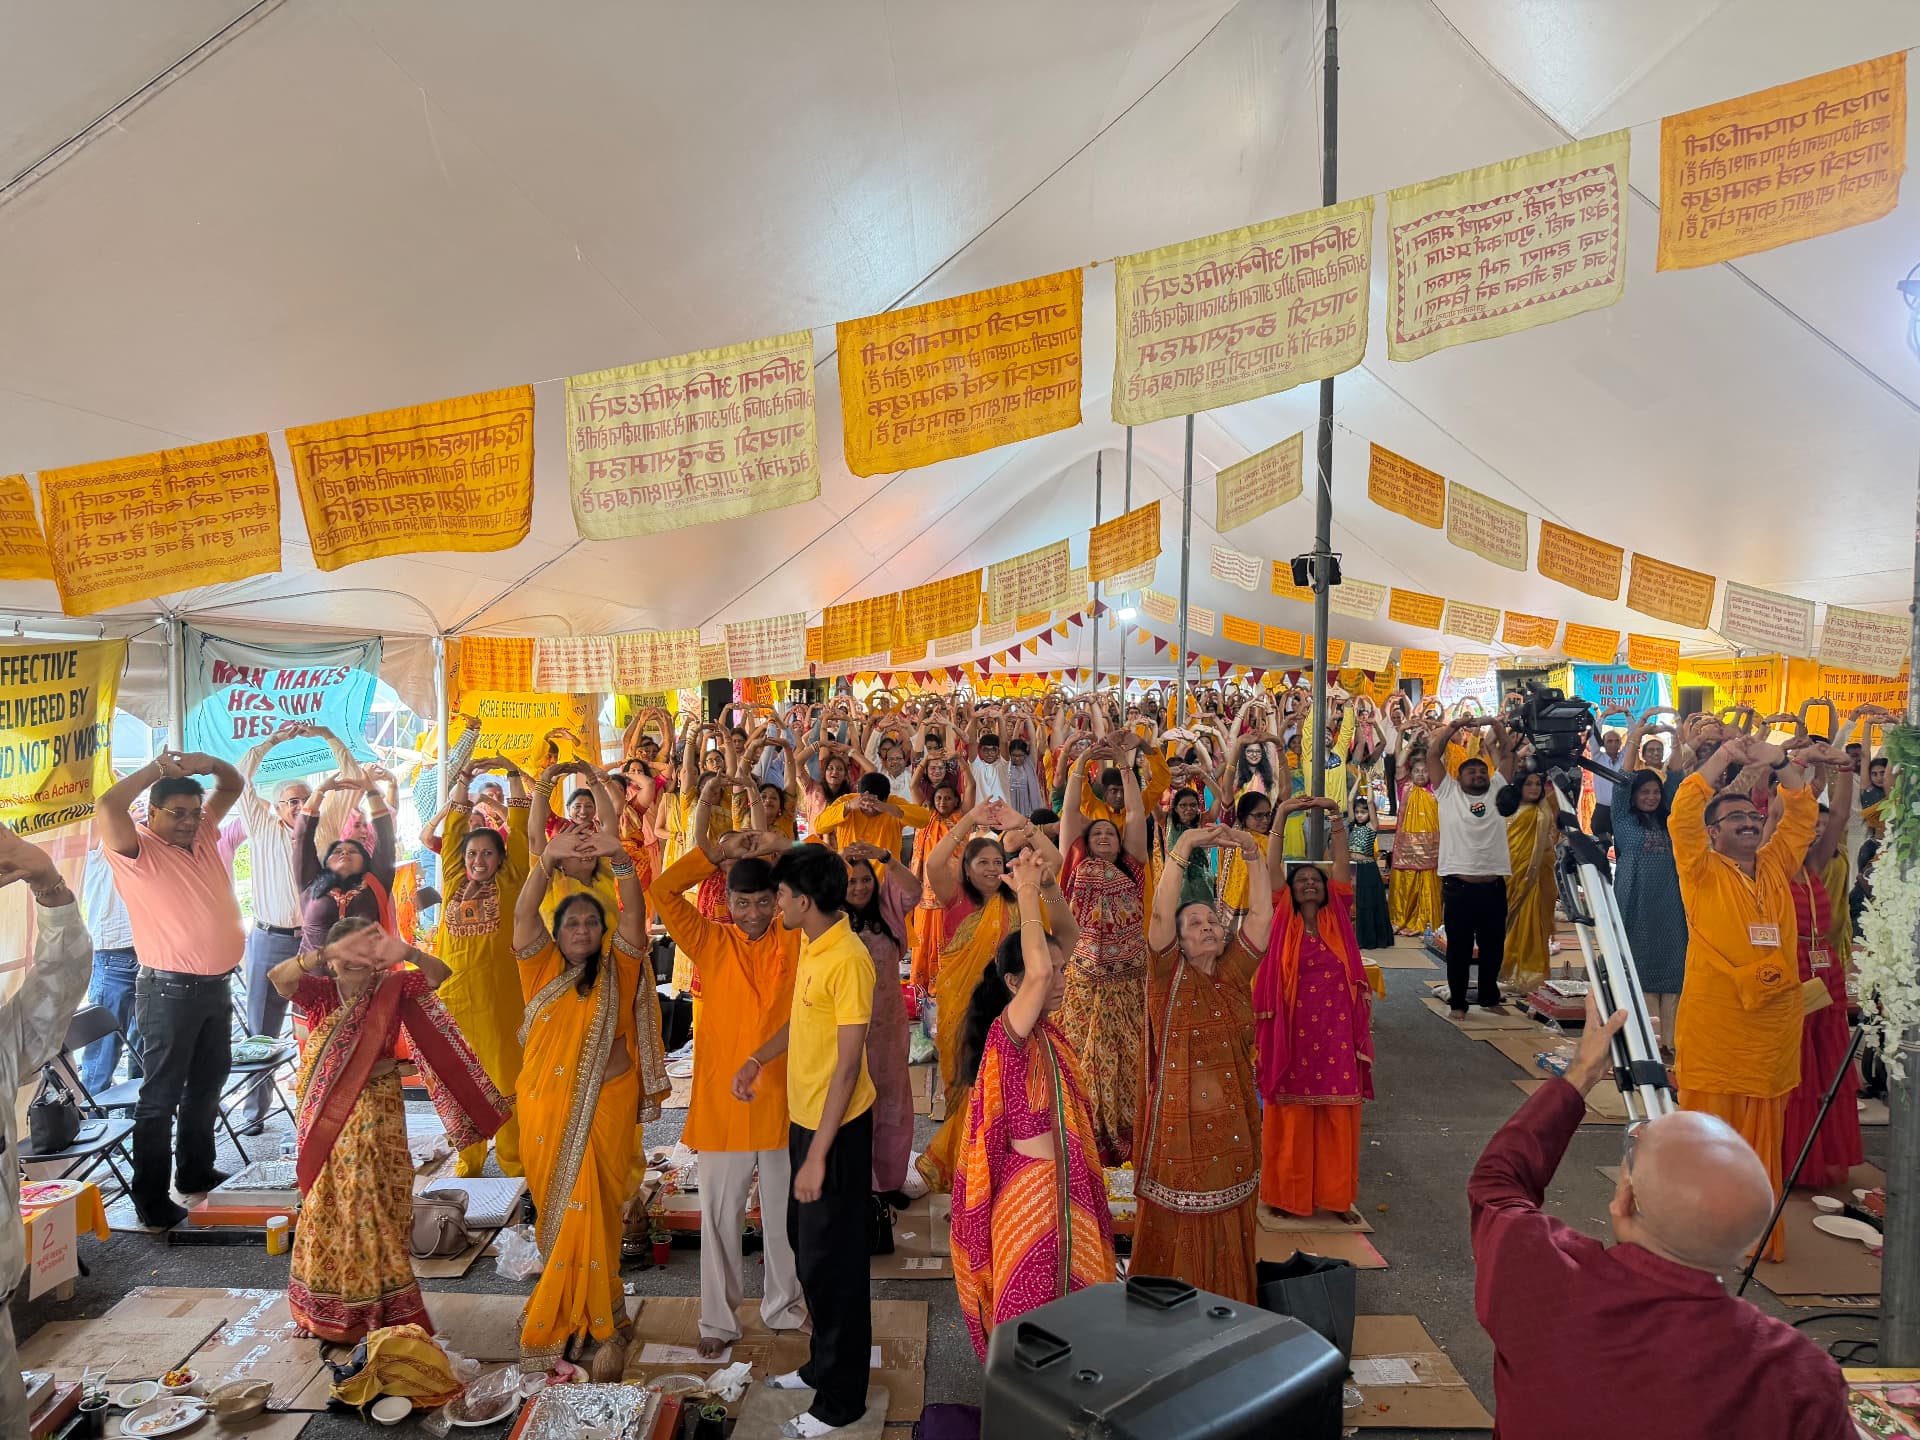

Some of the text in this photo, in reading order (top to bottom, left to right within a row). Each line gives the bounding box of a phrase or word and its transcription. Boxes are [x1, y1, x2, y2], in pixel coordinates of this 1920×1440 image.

[273, 665, 351, 690] MAKES
[1593, 672, 1648, 684] MAN MAKES
[1825, 673, 1839, 684] TIME
[1841, 674, 1848, 684] IS
[1849, 674, 1860, 684] THE
[1862, 674, 1878, 684] MOST
[70, 686, 89, 718] BY
[228, 689, 325, 716] HIS OWN
[1600, 685, 1639, 696] HIS OWN
[19, 739, 49, 775] NOT
[53, 733, 71, 767] BY
[52, 778, 89, 799] Acharya
[42, 1222, 55, 1250] 2
